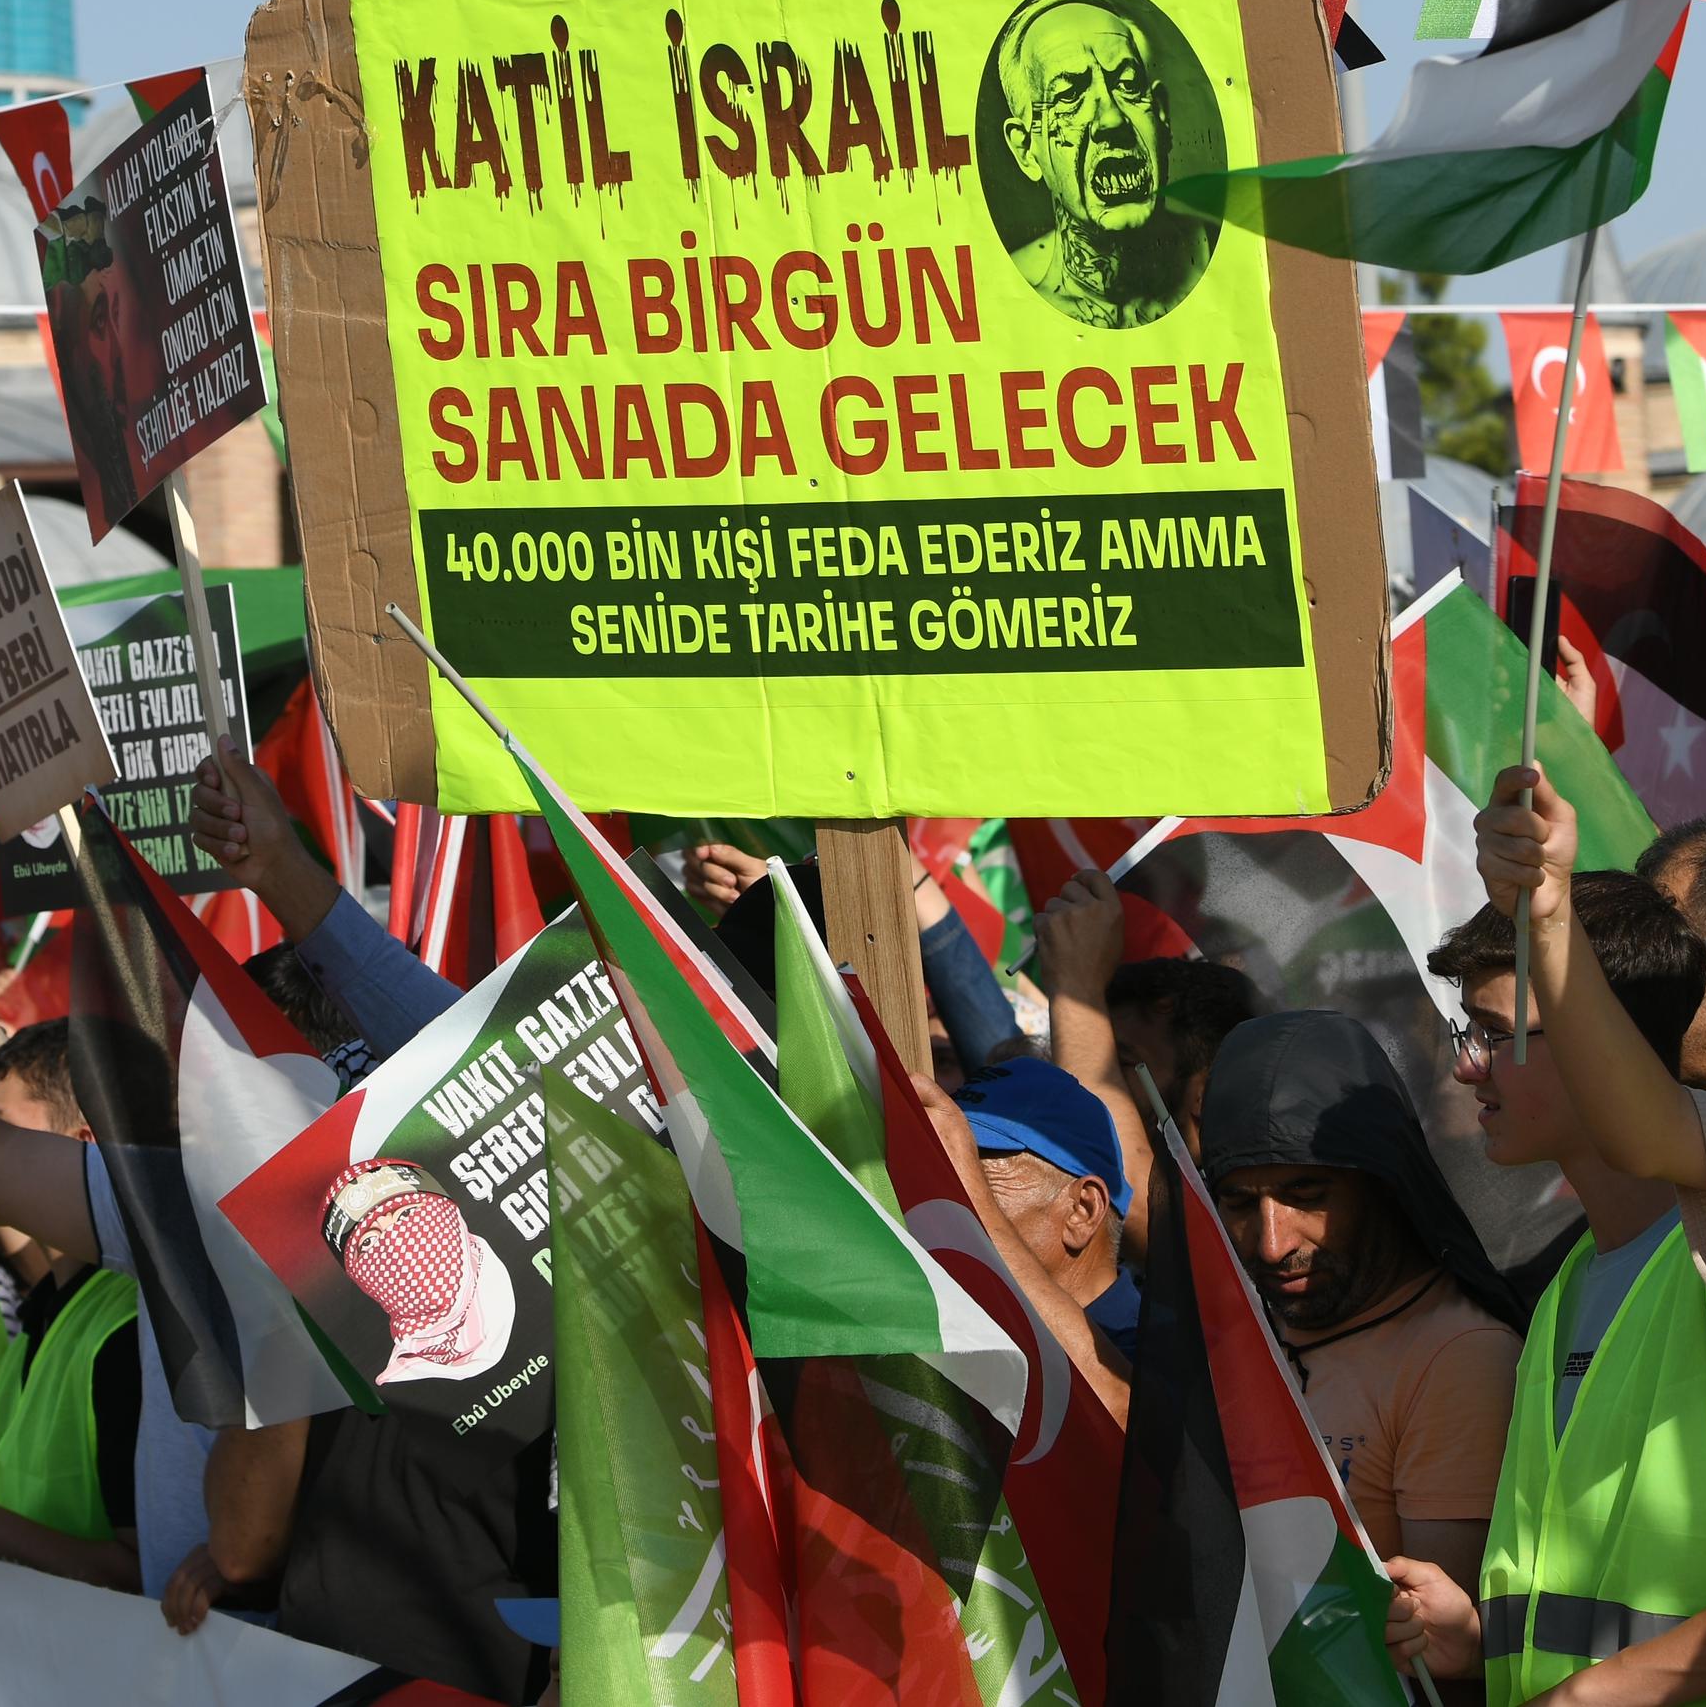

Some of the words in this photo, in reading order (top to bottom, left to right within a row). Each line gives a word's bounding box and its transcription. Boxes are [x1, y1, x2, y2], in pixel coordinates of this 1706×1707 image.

[393, 14, 633, 239] KATİL
[106, 153, 143, 222] ALLAH
[144, 173, 196, 254] FİLİSTİN
[195, 163, 217, 218] VE
[162, 218, 227, 307] ÜMMETİN
[416, 258, 608, 361] SIRA
[626, 222, 981, 355] BİRGÜN
[161, 307, 210, 376] ONURU
[204, 278, 239, 347] İÇİN
[136, 380, 196, 473] ŞEHİTLİĞE
[195, 342, 251, 421] HAZIRIZ
[429, 380, 798, 484] SANADA
[821, 362, 1257, 476] GELECEK
[446, 530, 595, 582] 40.000
[609, 517, 682, 581] BİN
[695, 513, 775, 594] KİŞİ
[792, 525, 906, 578] FEDA
[919, 507, 1086, 575] EDERİZ
[1100, 515, 1267, 570] AMMA
[571, 590, 728, 655] SENİDE
[740, 588, 892, 654] TARİHE
[908, 582, 1138, 651] GÖMERİZ
[122, 738, 157, 782] DİK
[33, 860, 68, 878] Ubeyde
[422, 1039, 526, 1140] VAKİT
[514, 960, 621, 1065] GAZZE
[451, 1399, 490, 1438] Ebû
[488, 1353, 549, 1413] Ubeyde
